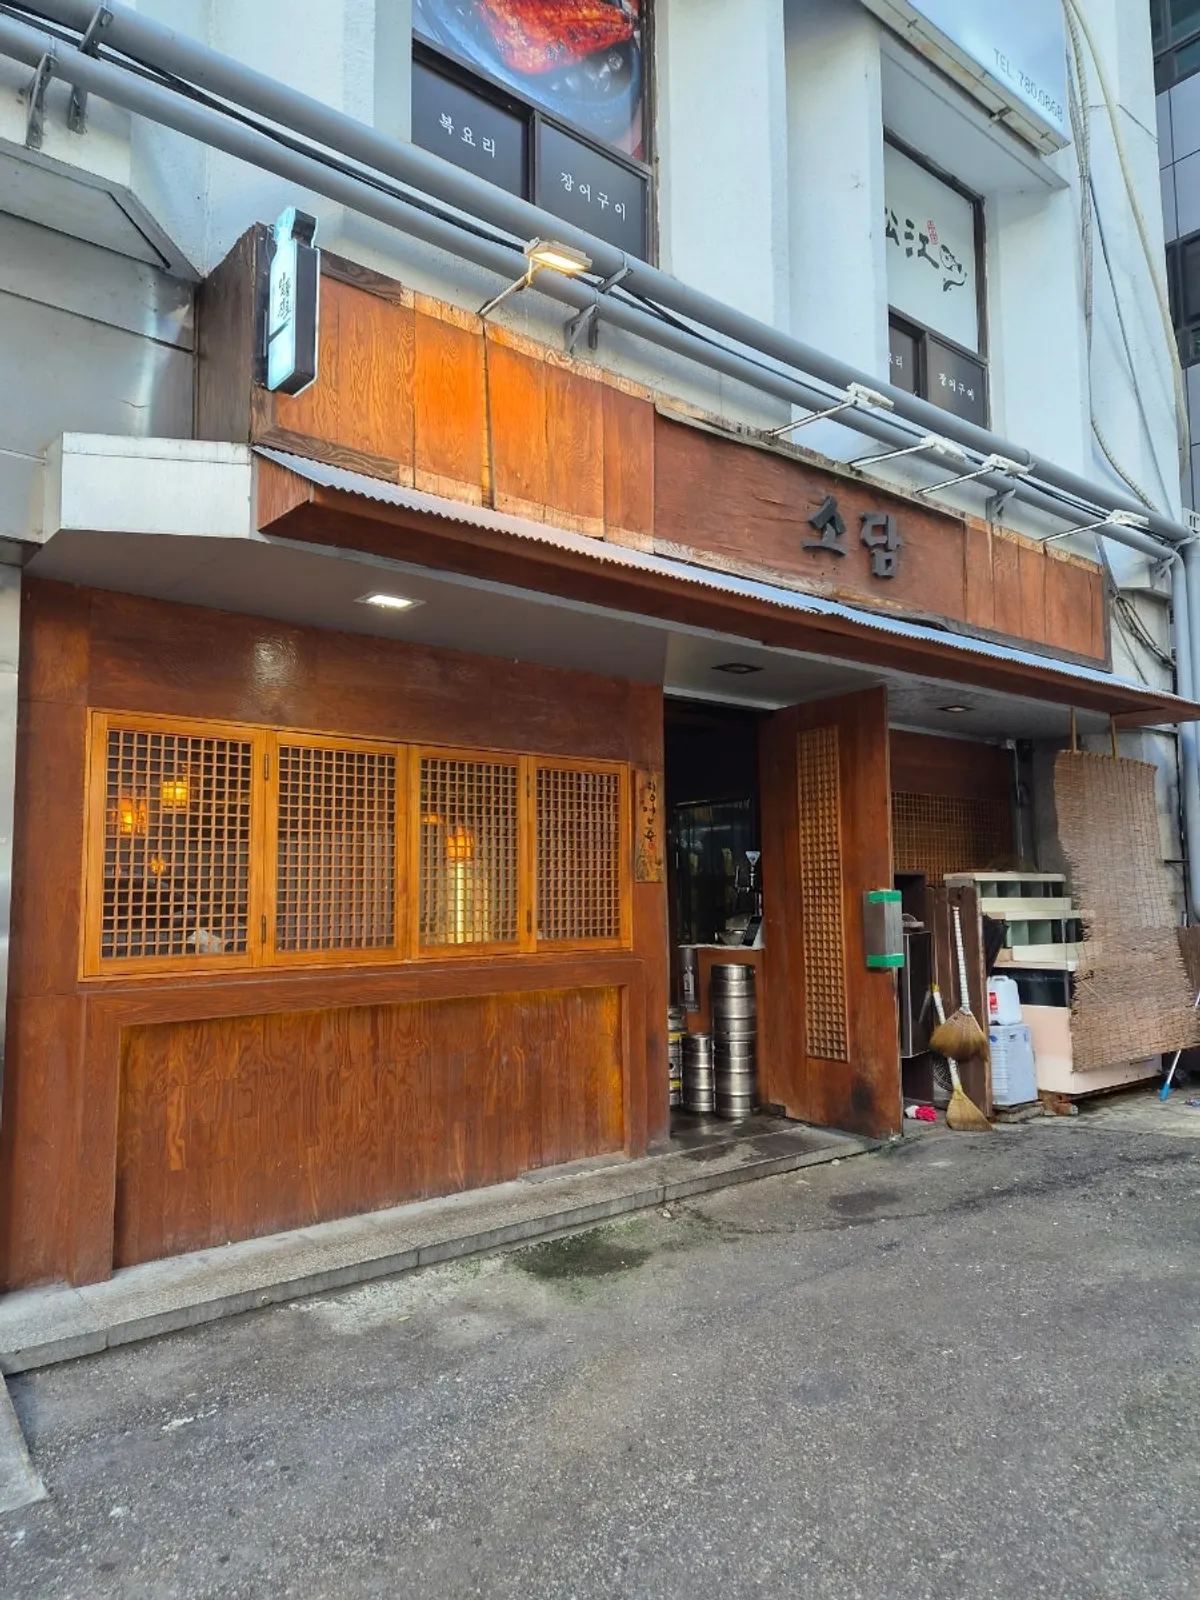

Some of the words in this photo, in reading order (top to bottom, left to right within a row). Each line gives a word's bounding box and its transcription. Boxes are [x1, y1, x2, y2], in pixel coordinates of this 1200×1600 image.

[438, 112, 497, 159] 복요리
[560, 171, 627, 222] 장어구이
[800, 493, 903, 579] 소담
